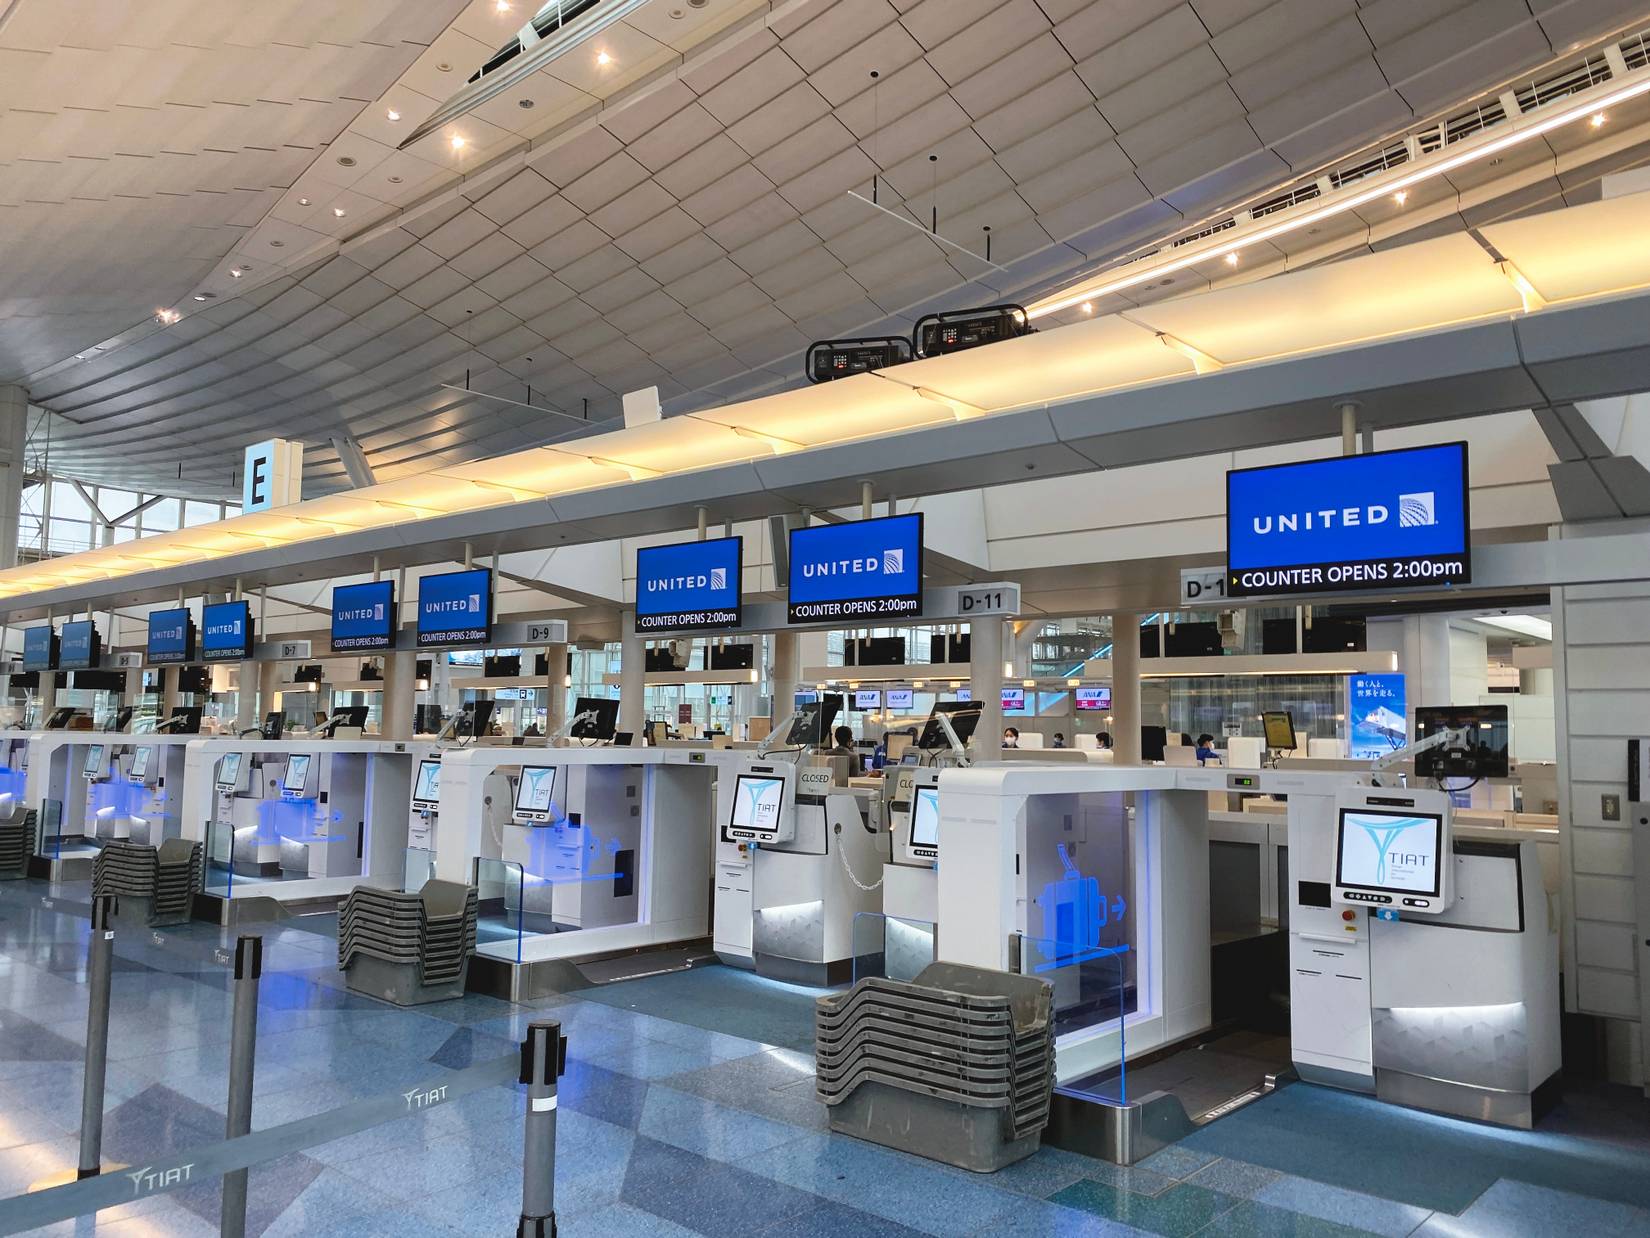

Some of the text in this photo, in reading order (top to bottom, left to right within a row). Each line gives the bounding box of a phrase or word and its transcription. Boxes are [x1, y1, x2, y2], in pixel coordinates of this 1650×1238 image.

[252, 456, 265, 503] E
[1253, 505, 1389, 535] UNITED
[803, 557, 878, 578] UNITED
[1241, 559, 1463, 588] COUNTER OPENS 2:00pm
[647, 575, 707, 592] UNITED
[1186, 578, 1225, 598] D-1
[425, 599, 467, 613] UNITED
[795, 598, 917, 618] COUNTER OPENS 2:00pm
[962, 592, 1002, 611] D-11
[338, 608, 373, 621] UNITED
[641, 611, 737, 627] COUNTER OPENS 2:00pm
[151, 630, 176, 640] UNITED
[207, 623, 233, 635] UNITED
[421, 630, 486, 642] COUNTER OPENS 2:00pm
[532, 627, 549, 640] D-9
[334, 637, 389, 648] COUNTER OPENS 2:00pm
[284, 645, 296, 656] D-7
[801, 774, 829, 783] CLOSED
[900, 779, 914, 789] CLO
[757, 803, 776, 812] TIAT
[1388, 852, 1430, 866] TIAT
[415, 1085, 448, 1108] TIAT
[145, 1163, 194, 1190] TIAT
